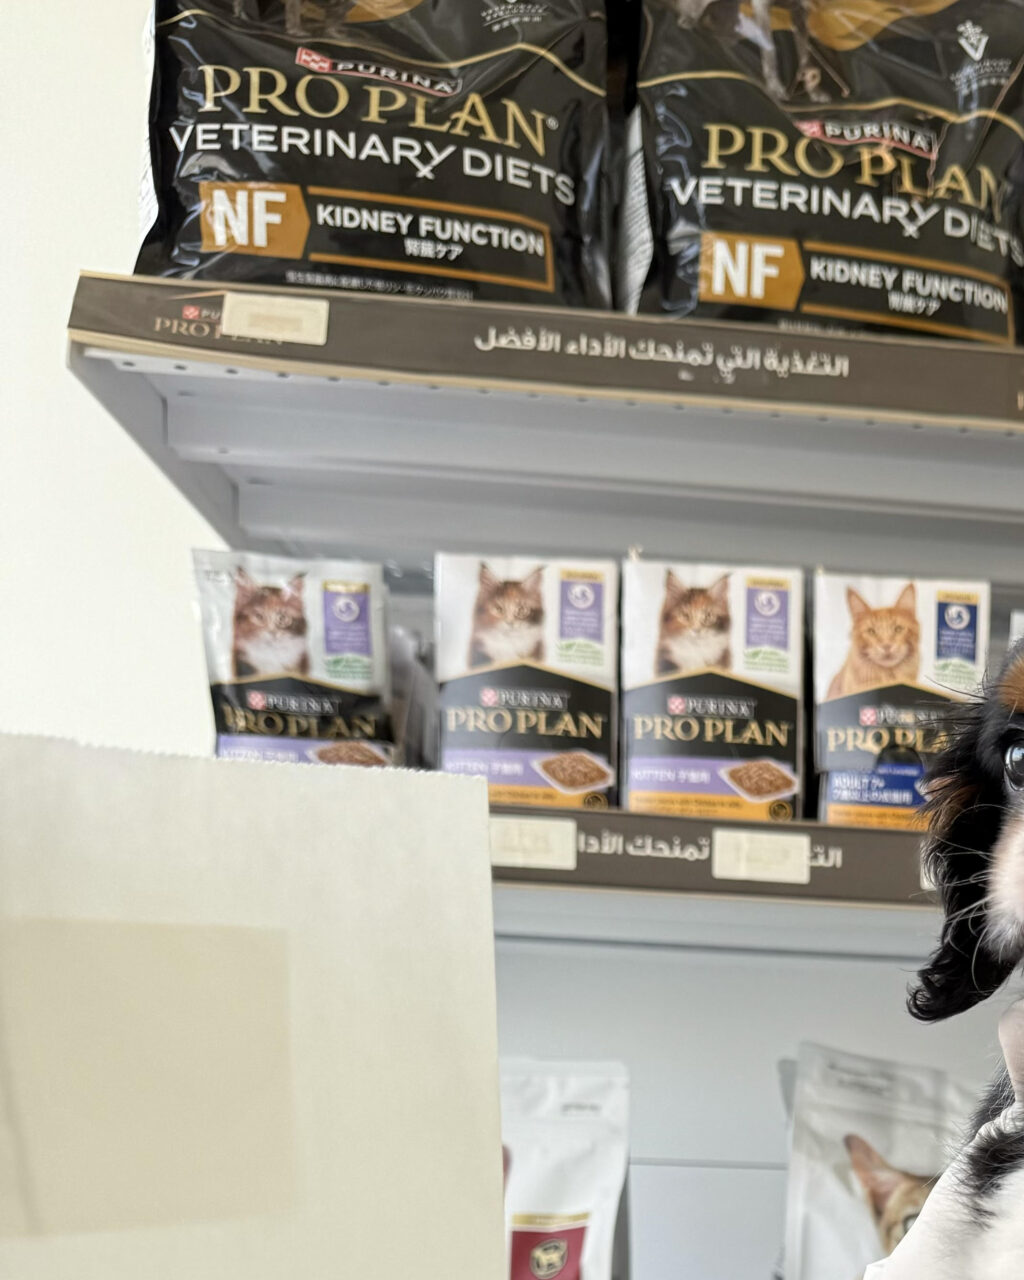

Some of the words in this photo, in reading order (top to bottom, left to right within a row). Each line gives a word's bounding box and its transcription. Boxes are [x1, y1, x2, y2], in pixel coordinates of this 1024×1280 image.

[198, 64, 349, 119] PRO
[336, 62, 459, 94] PURINA
[824, 121, 936, 150] PURINA
[169, 123, 457, 180] VETERINARY
[463, 148, 576, 206] DIETS
[702, 123, 845, 179] PRO
[859, 144, 1004, 223] PLAN
[212, 188, 286, 248] NF
[670, 177, 940, 239] VETERINARY
[316, 203, 412, 239] KIDNEY
[418, 214, 545, 258] FUNCTION
[711, 241, 786, 299] NF
[811, 256, 898, 291] KIDNEY
[901, 270, 1008, 315] FUNCTION
[154, 317, 210, 338] PRO
[474, 326, 561, 354] الأفضل
[565, 330, 626, 360] الأداء
[628, 339, 714, 366] تمنحك
[715, 345, 761, 378] التي
[763, 348, 849, 379] التغذية
[287, 711, 377, 738] PLAN
[446, 706, 513, 734] PRO
[516, 709, 603, 738] PLAN
[633, 714, 700, 742] PRO
[704, 717, 790, 747] PLAN
[827, 727, 891, 755] PRO
[895, 727, 952, 753] PLA
[578, 830, 623, 855] الأدا
[625, 834, 710, 861] تمنحك
